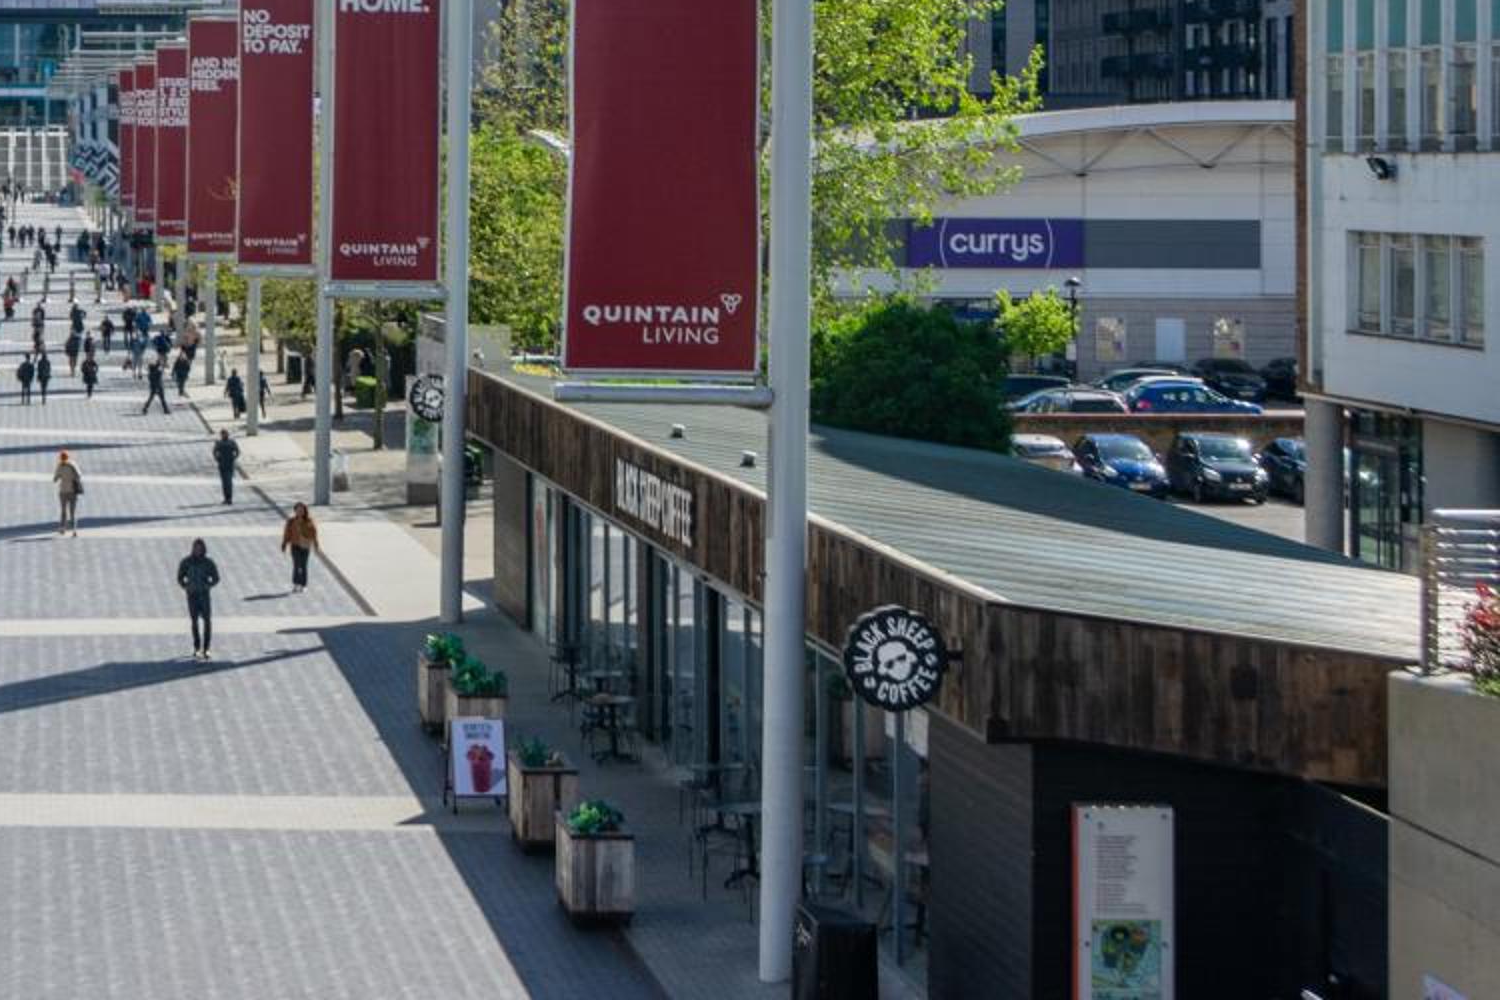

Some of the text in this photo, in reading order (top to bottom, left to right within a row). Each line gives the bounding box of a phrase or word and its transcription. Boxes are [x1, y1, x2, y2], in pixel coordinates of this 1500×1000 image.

[244, 10, 270, 23] NO
[244, 24, 310, 38] DEPOSIT
[244, 40, 302, 54] TO PAY.
[192, 58, 220, 69] AND
[244, 237, 298, 248] QUINTAIN
[340, 243, 418, 256] QUINTAIN
[950, 231, 1045, 260] currys
[374, 256, 418, 266] LIVING
[583, 304, 720, 326] QUINTAIN
[642, 326, 719, 344] LIVING
[662, 481, 692, 547] COFFEE
[854, 616, 935, 673] BLACK SHEEP
[877, 666, 937, 704] COFFEE
